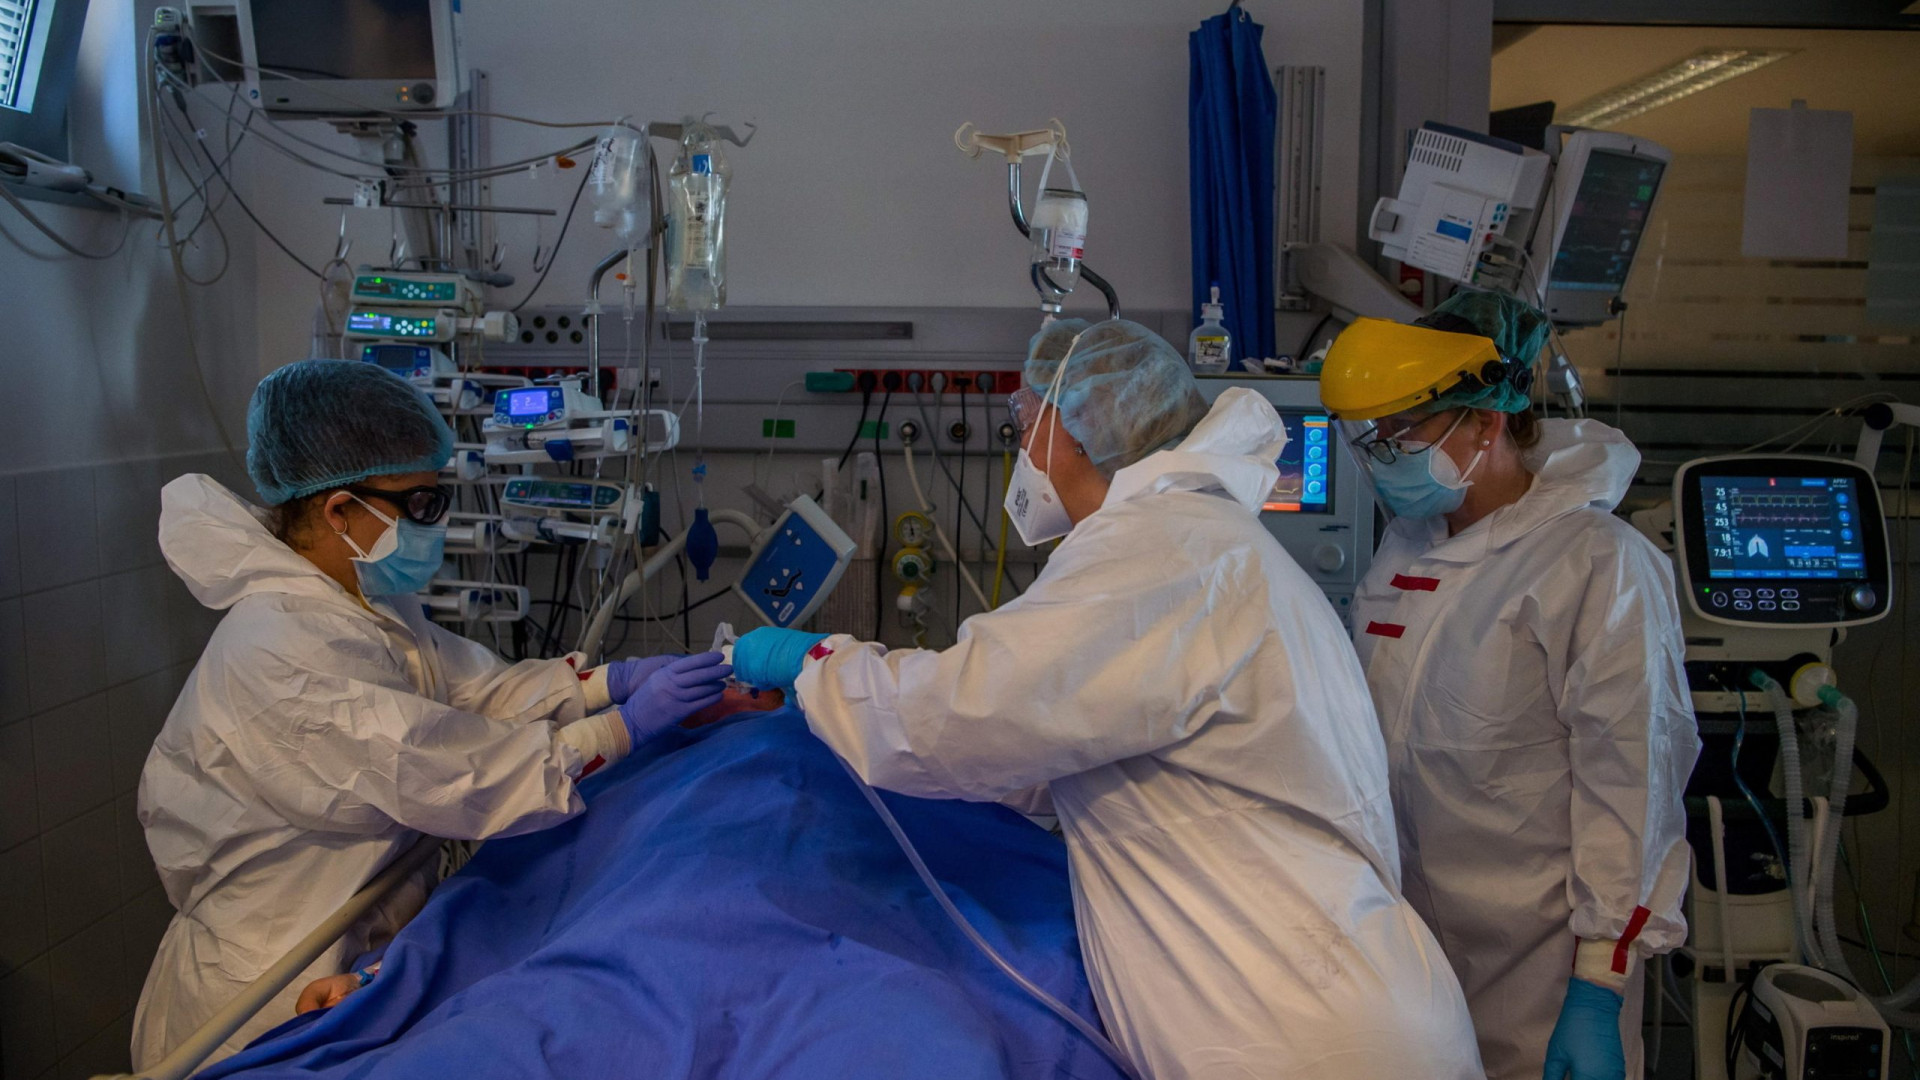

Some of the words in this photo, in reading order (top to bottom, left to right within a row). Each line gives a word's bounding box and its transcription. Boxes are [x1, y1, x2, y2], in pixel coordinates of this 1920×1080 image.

[1716, 487, 1726, 496] 25
[1715, 518, 1729, 527] 253
[1721, 533, 1731, 541] 18
[1830, 1033, 1859, 1042] inspired
